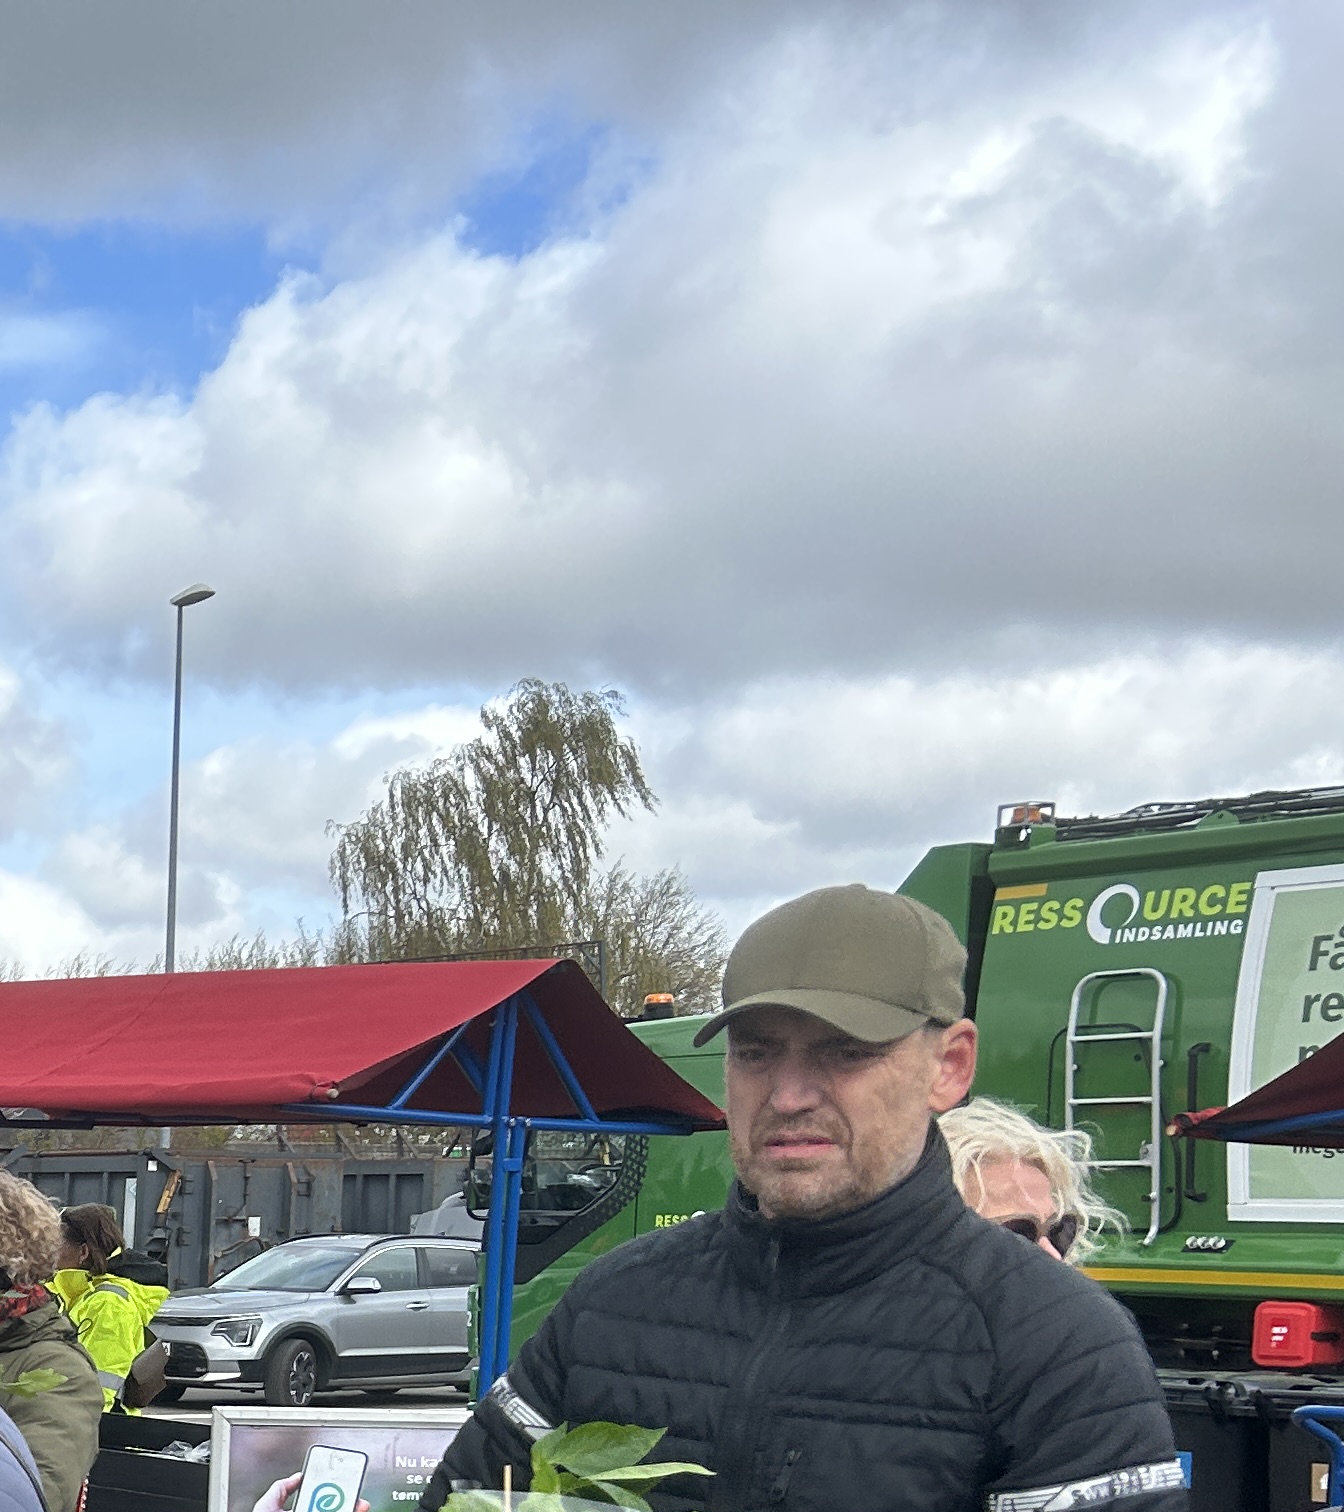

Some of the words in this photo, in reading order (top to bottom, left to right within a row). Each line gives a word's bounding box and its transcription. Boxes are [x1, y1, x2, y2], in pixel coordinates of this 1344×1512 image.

[1113, 918, 1245, 945] INDSAMLING
[395, 1455, 417, 1468] Nu
[420, 1456, 442, 1468] ka
[406, 1474, 423, 1485] se
